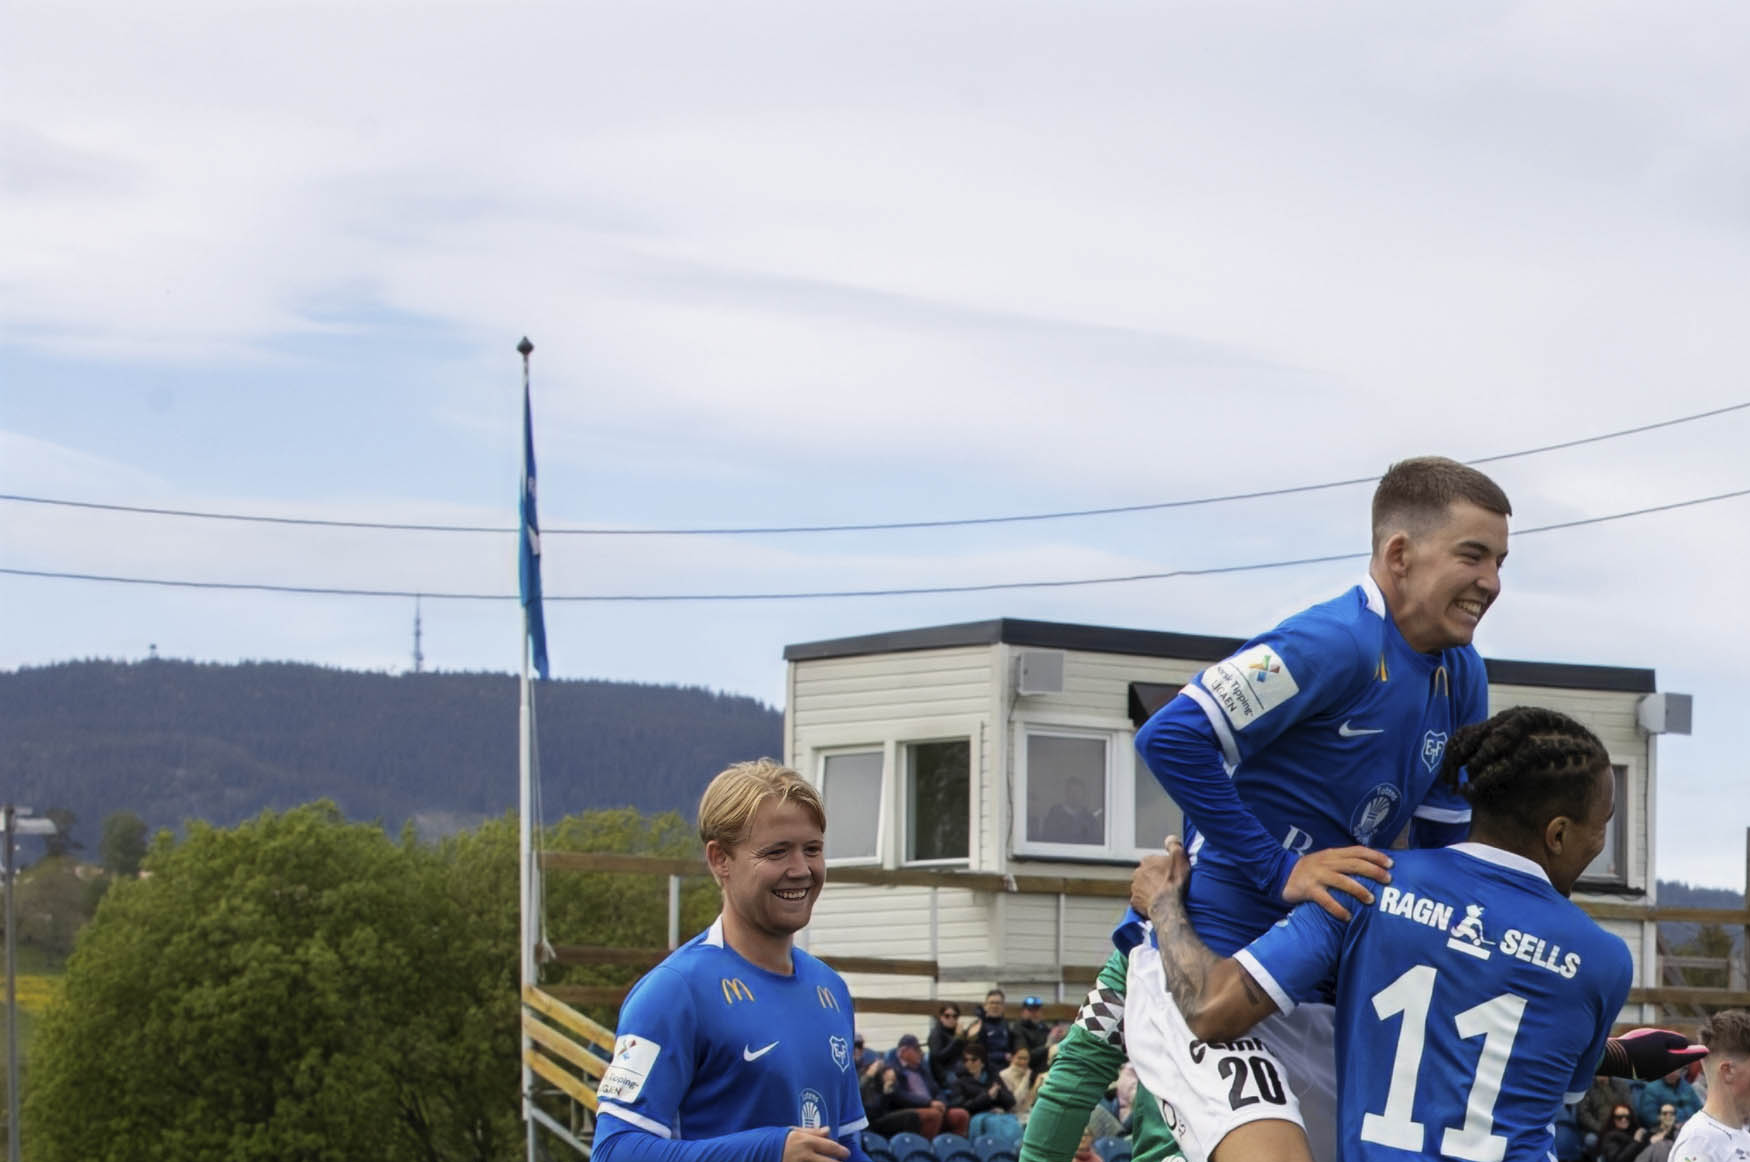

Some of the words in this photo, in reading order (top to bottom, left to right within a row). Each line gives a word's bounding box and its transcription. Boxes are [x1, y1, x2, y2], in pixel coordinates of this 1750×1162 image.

[1379, 886, 1453, 931] RAGN
[1499, 929, 1582, 979] SELLS
[1217, 1055, 1288, 1111] 20
